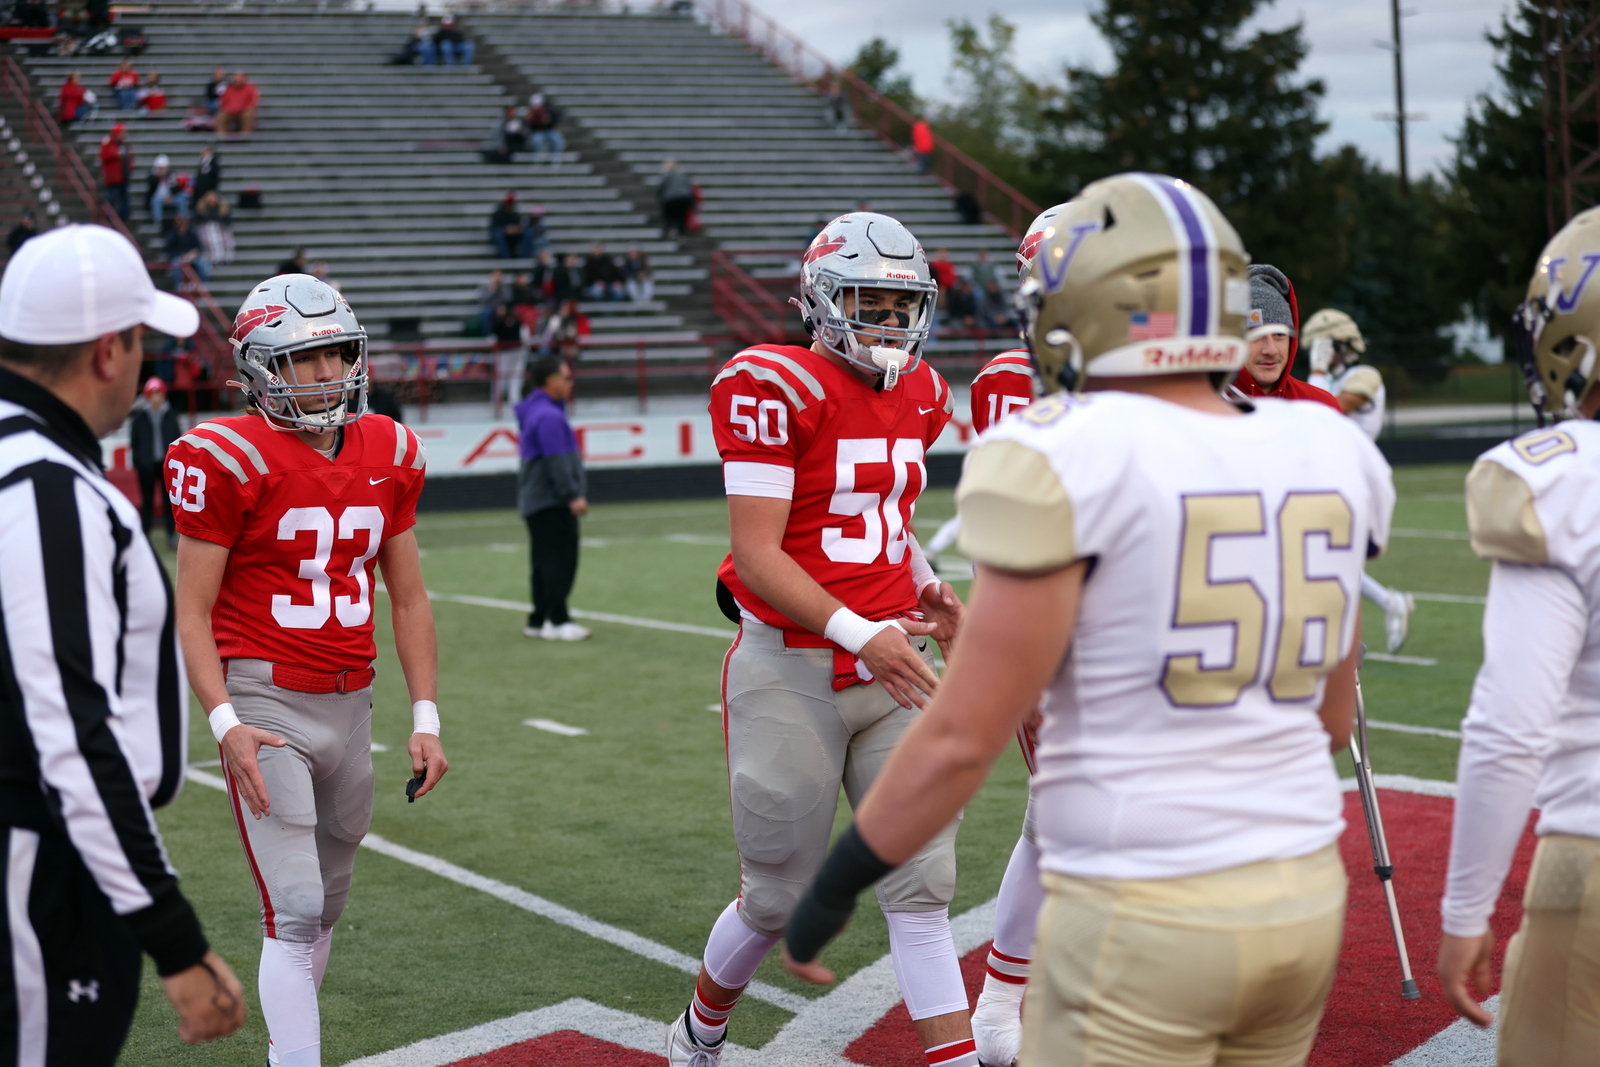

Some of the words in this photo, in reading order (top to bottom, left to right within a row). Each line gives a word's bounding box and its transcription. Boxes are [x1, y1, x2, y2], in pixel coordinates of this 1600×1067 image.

[1142, 342, 1237, 368] Riddell
[730, 395, 788, 446] 50
[168, 459, 206, 512] 33
[821, 438, 927, 565] 50
[271, 506, 385, 630] 33
[1157, 490, 1355, 708] 56
